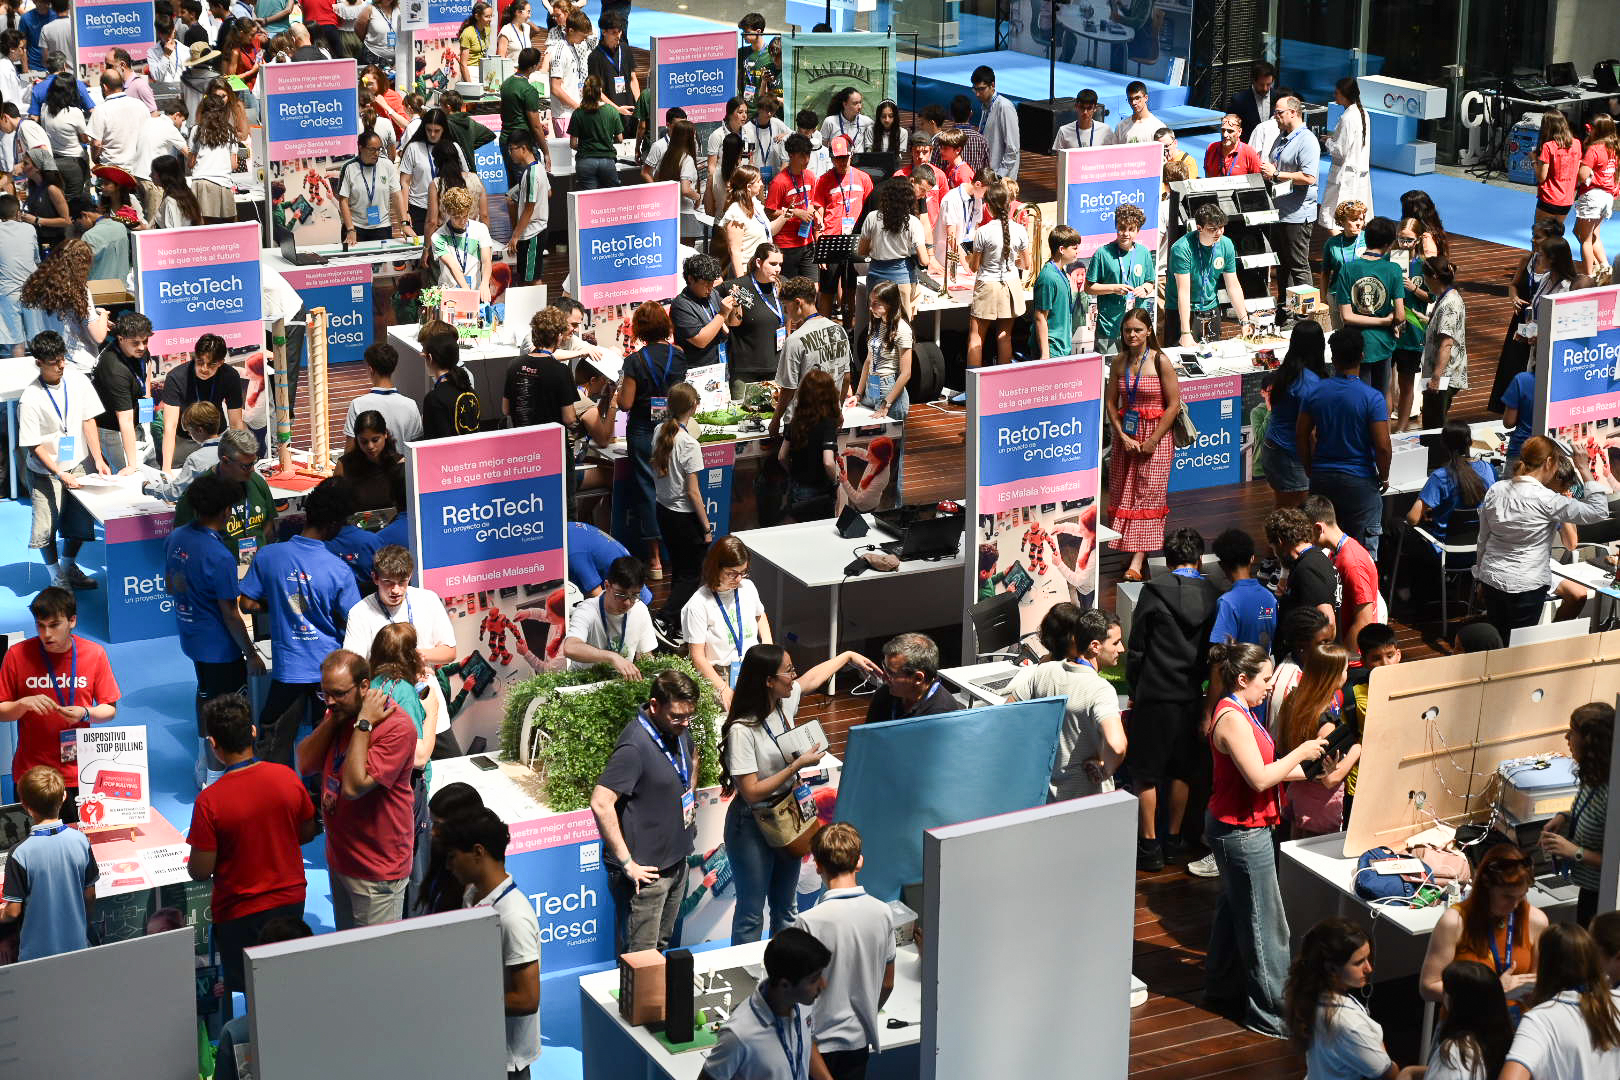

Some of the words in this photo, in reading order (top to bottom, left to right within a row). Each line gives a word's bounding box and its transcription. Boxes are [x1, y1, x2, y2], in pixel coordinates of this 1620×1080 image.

[85, 11, 140, 26] RetoTech
[103, 26, 141, 36] endesa
[669, 68, 724, 85] RetoTech
[686, 84, 724, 96] endesa
[280, 98, 343, 117] RetoTech
[1383, 92, 1422, 114] enel
[300, 116, 343, 128] endesa
[473, 152, 503, 165] Tech
[476, 169, 503, 180] desa
[1080, 188, 1145, 208] RetoTech
[591, 231, 662, 255] RetoTech
[614, 253, 662, 268] endesa
[159, 274, 243, 298] RetoTech
[186, 297, 244, 312] endesa
[326, 309, 363, 328] Tech
[165, 336, 178, 346] IES
[179, 334, 200, 345] Barri
[327, 331, 364, 344] desa
[1563, 343, 1620, 367] RetoTec
[1584, 365, 1615, 381] ende
[999, 387, 1029, 397] Nuestra
[1030, 384, 1052, 394] mejor
[1054, 378, 1083, 391] energía
[998, 401, 1008, 409] es
[1017, 399, 1032, 409] que
[1033, 395, 1049, 404] reta
[1050, 393, 1057, 401] al
[1058, 390, 1083, 400] futuro
[1569, 405, 1582, 416] IES
[1582, 404, 1595, 414] Las
[1596, 401, 1617, 412] Rozas
[998, 417, 1083, 447] RetoTech
[1023, 441, 1082, 462] endesa
[441, 461, 477, 474] Nuestra
[478, 457, 505, 470] mejor
[506, 451, 542, 466] energía
[1175, 452, 1231, 470] endesa
[441, 477, 452, 485] es
[453, 474, 462, 484] la
[464, 474, 481, 486] que
[483, 470, 502, 480] reta
[503, 467, 512, 477] al
[513, 464, 542, 475] futuro
[999, 491, 1012, 502] IES
[1012, 488, 1039, 499] Malala
[1039, 480, 1081, 495] Yousafzai
[442, 492, 543, 526] RetoTech
[443, 526, 453, 534] un
[453, 523, 481, 534] proyecto
[475, 520, 544, 543] endesa
[445, 576, 461, 587] IES
[462, 570, 502, 585] Manuela
[502, 563, 545, 578] Malasaña
[135, 593, 165, 604] proyecto
[83, 731, 126, 743] DISPOSITIVO
[96, 743, 113, 753] STOP
[511, 828, 538, 839] uestra
[540, 824, 565, 836] mejor
[567, 817, 596, 830] energí
[516, 839, 523, 849] la
[525, 838, 542, 850] que
[543, 835, 562, 845] reta
[563, 832, 571, 841] al
[528, 884, 597, 918] Tech
[539, 918, 597, 944] desa
[567, 936, 597, 947] Fundación
